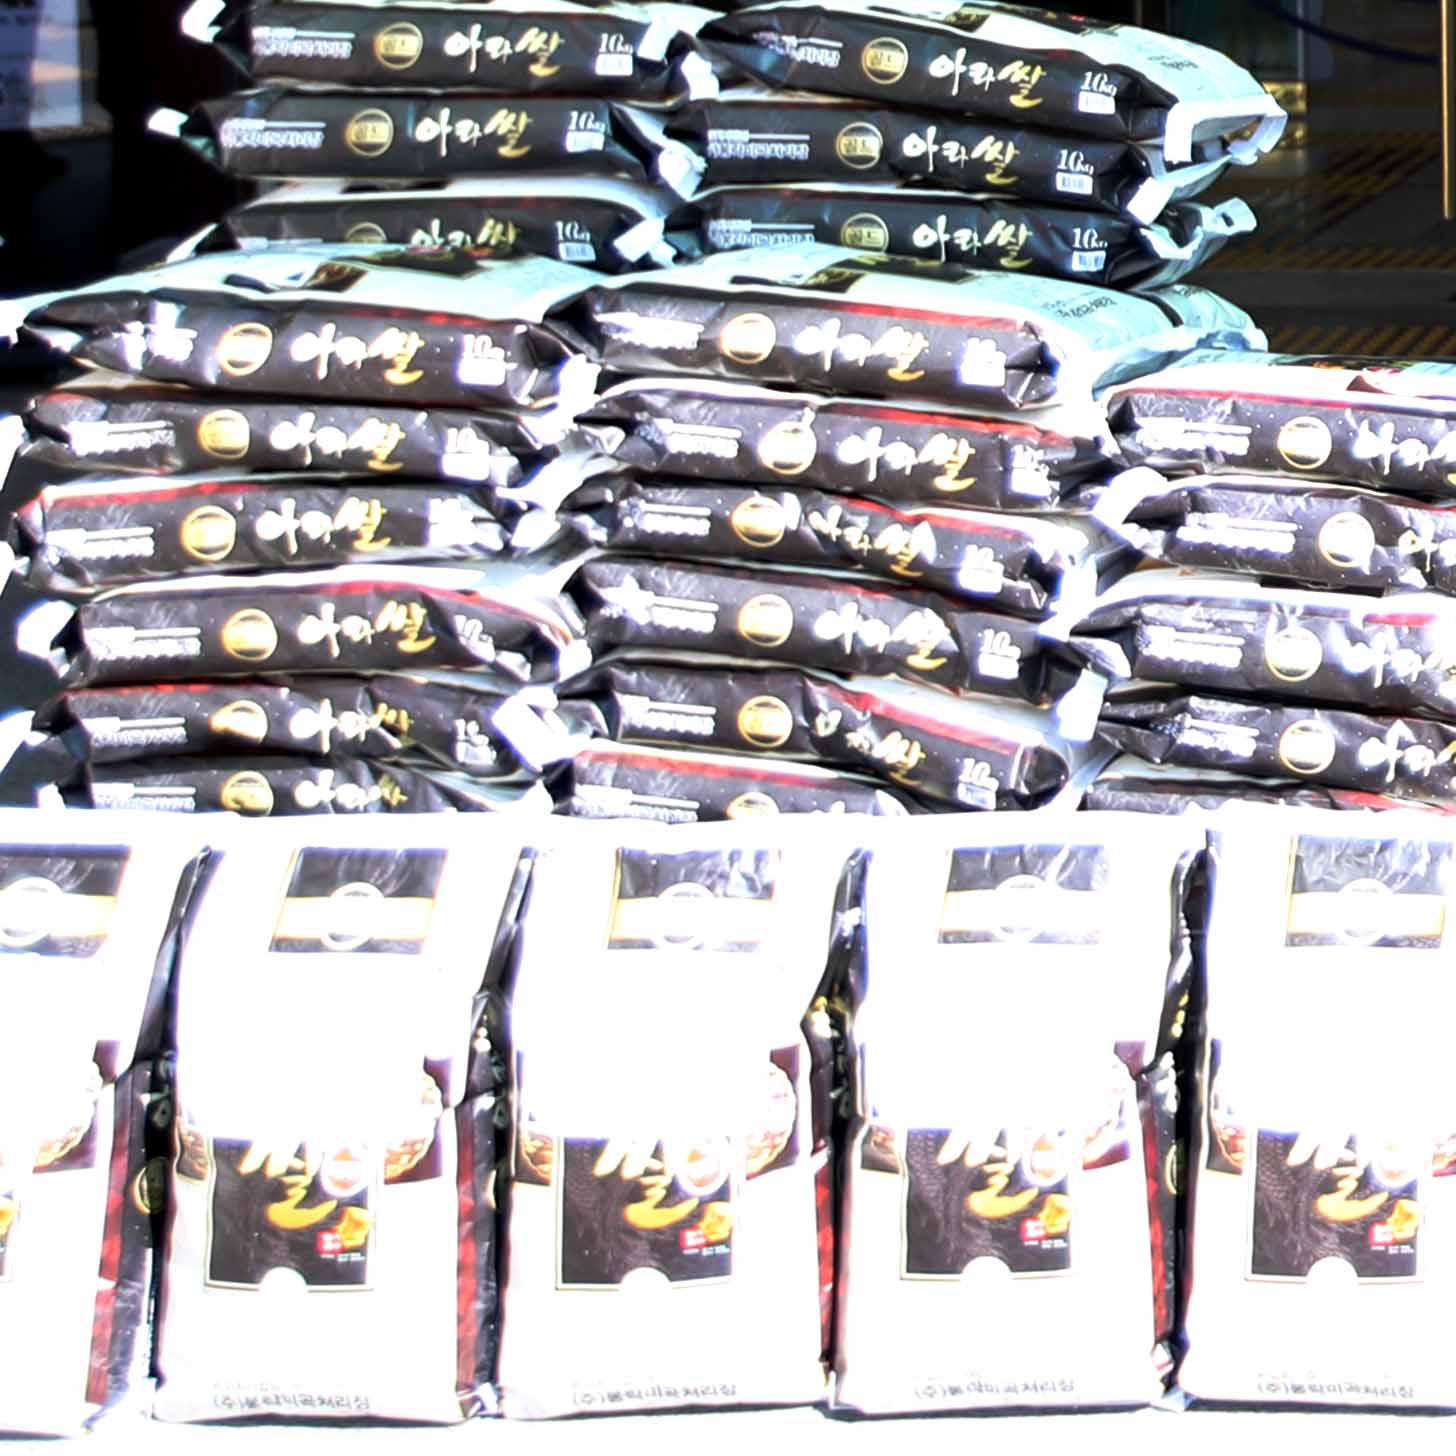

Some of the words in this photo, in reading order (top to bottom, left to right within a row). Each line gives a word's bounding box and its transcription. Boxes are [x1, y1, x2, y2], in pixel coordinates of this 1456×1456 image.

[444, 25, 565, 77] 아라쌀
[929, 48, 1047, 108] 아라쌀
[414, 108, 531, 158] 아라쌀
[902, 127, 1020, 185] 아라쌀
[913, 214, 1032, 268] 아라쌀
[290, 325, 424, 385] 아라쌀
